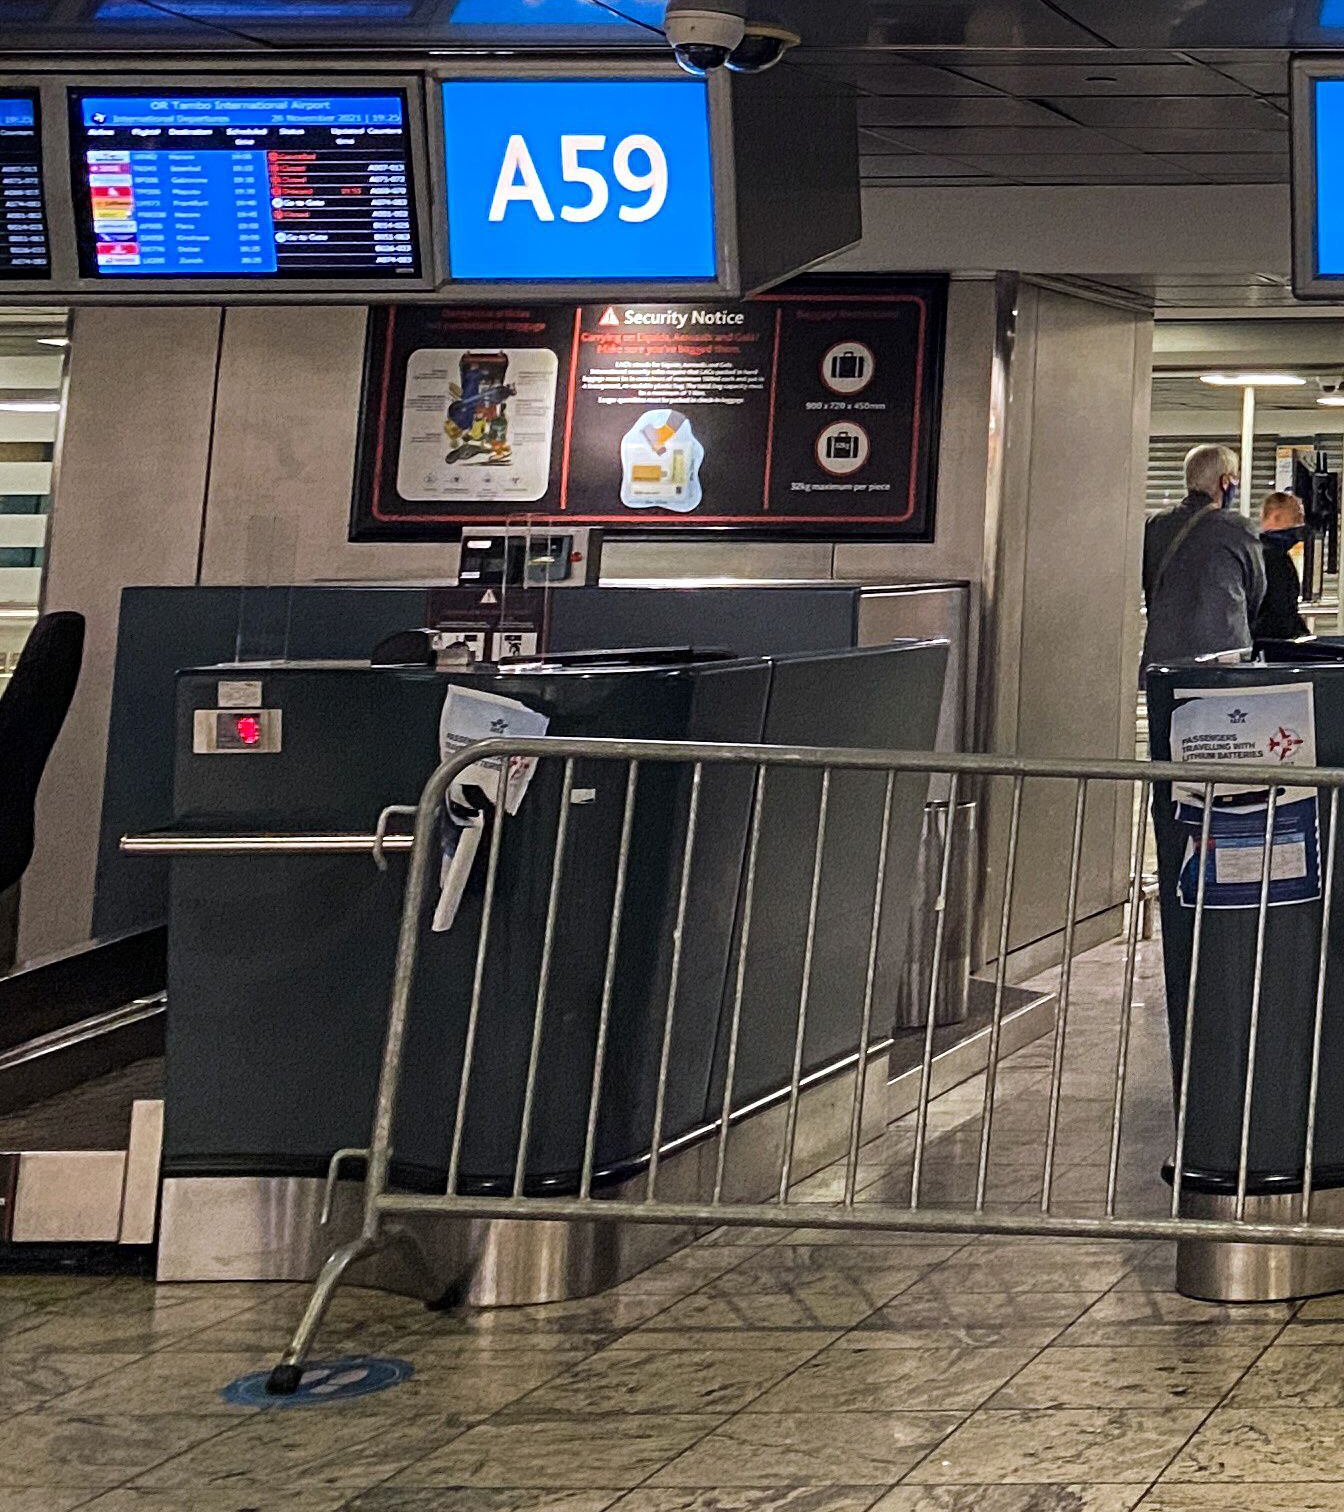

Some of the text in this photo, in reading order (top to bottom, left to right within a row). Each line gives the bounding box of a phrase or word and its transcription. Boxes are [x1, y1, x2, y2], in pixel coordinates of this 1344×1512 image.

[489, 134, 669, 223] A59
[624, 310, 744, 328] Security Notice
[1182, 734, 1237, 744] PASSENGERS
[1217, 750, 1263, 760] BATTERIES
